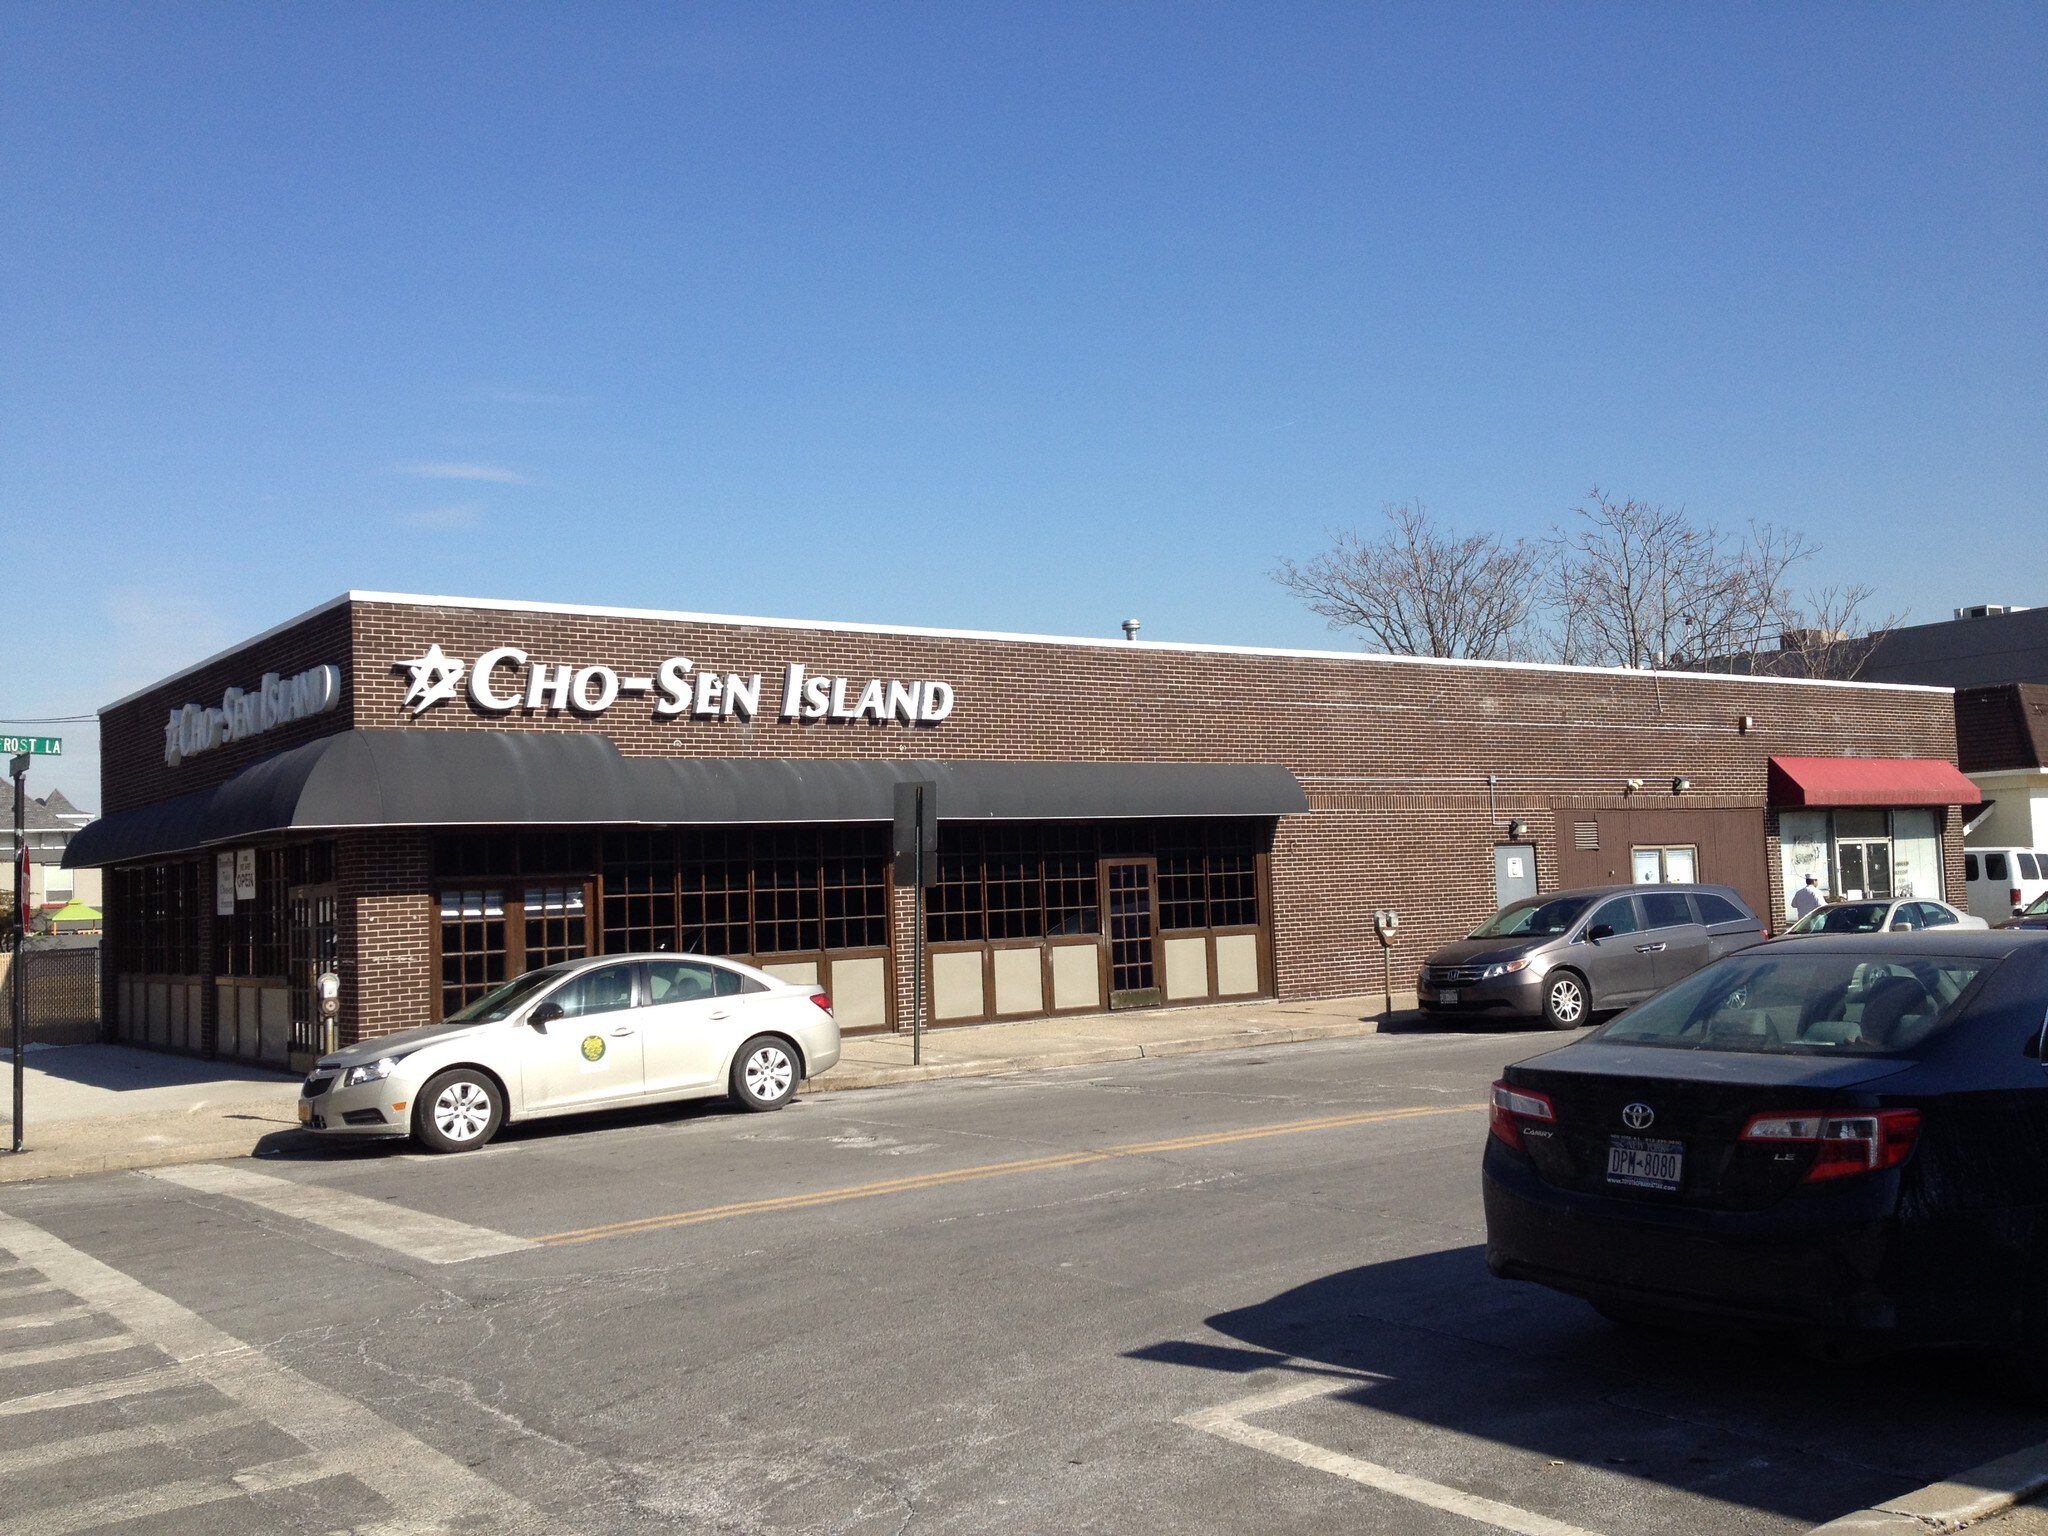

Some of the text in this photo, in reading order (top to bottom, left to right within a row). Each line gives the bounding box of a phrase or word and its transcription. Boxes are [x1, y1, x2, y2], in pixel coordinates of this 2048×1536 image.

[467, 646, 955, 721] CHO-SEN ISLAND
[0, 738, 61, 754] ROST LA
[1774, 1153, 1795, 1161] LE
